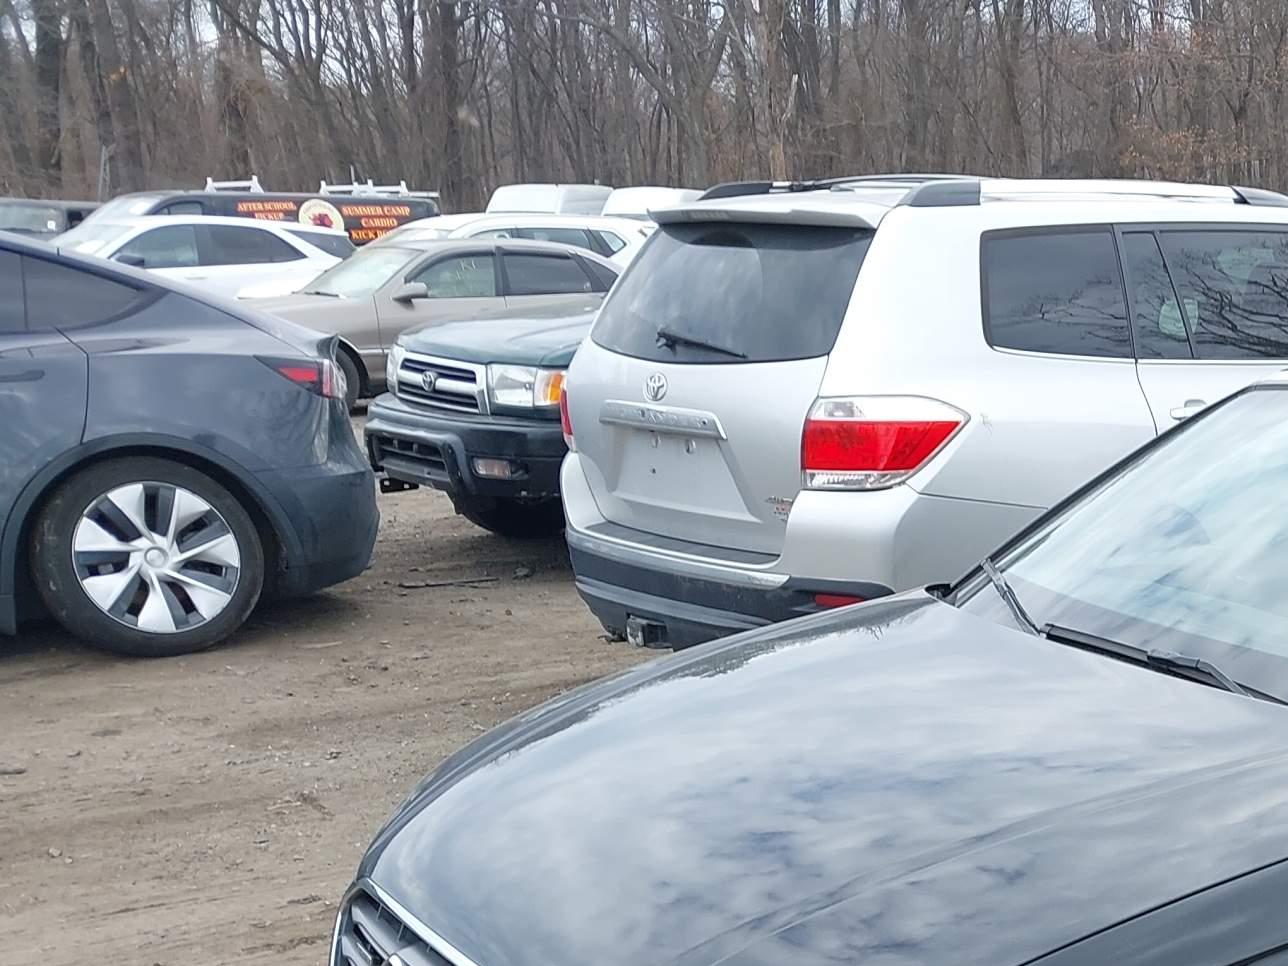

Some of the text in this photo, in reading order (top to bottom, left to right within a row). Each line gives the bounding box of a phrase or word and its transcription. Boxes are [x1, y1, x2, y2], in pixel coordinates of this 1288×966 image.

[237, 201, 263, 211] AFTER
[264, 200, 297, 210] SCHOOL
[342, 205, 383, 216] SUMMER
[383, 205, 411, 216] CAMP
[361, 217, 398, 228] CARDIO
[351, 229, 376, 240] KICK
